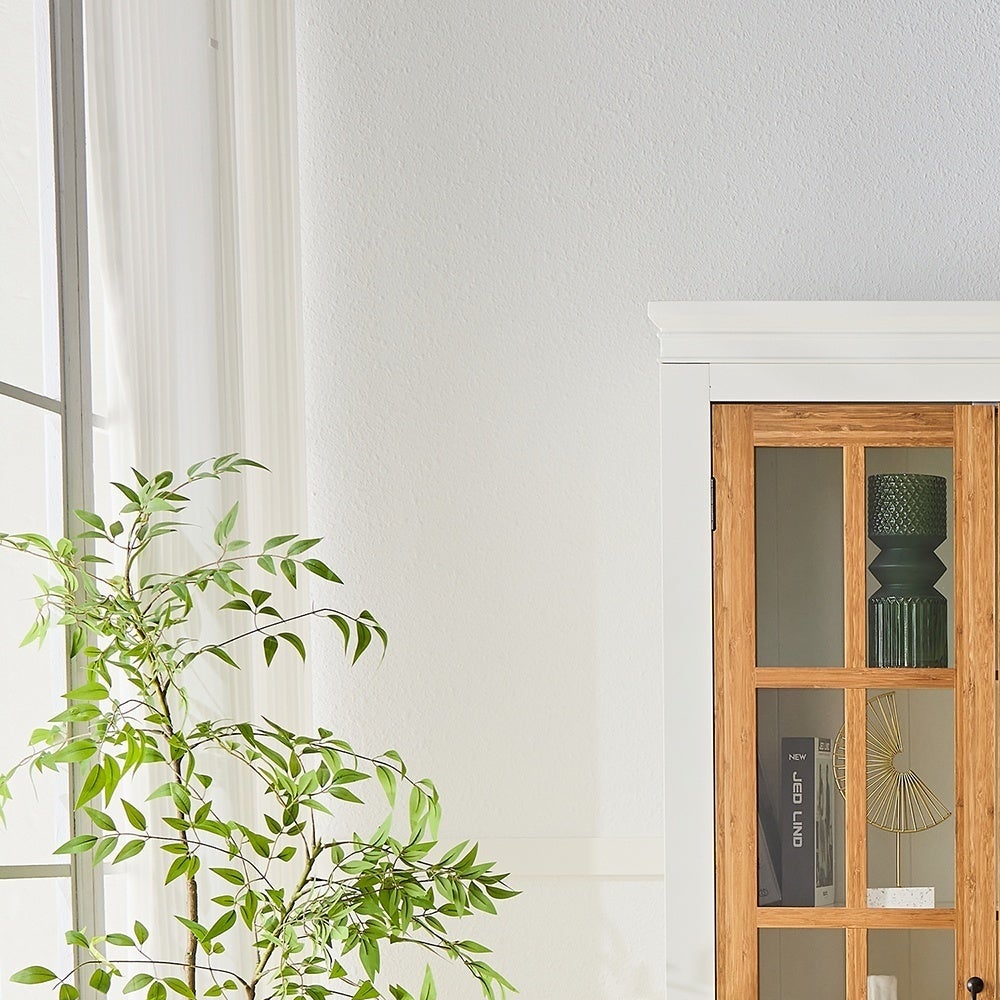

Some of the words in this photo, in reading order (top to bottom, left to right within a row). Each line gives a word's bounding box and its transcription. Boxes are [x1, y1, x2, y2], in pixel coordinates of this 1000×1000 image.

[788, 753, 807, 761] NEW
[793, 771, 803, 804] JED
[793, 811, 803, 848] LIND
